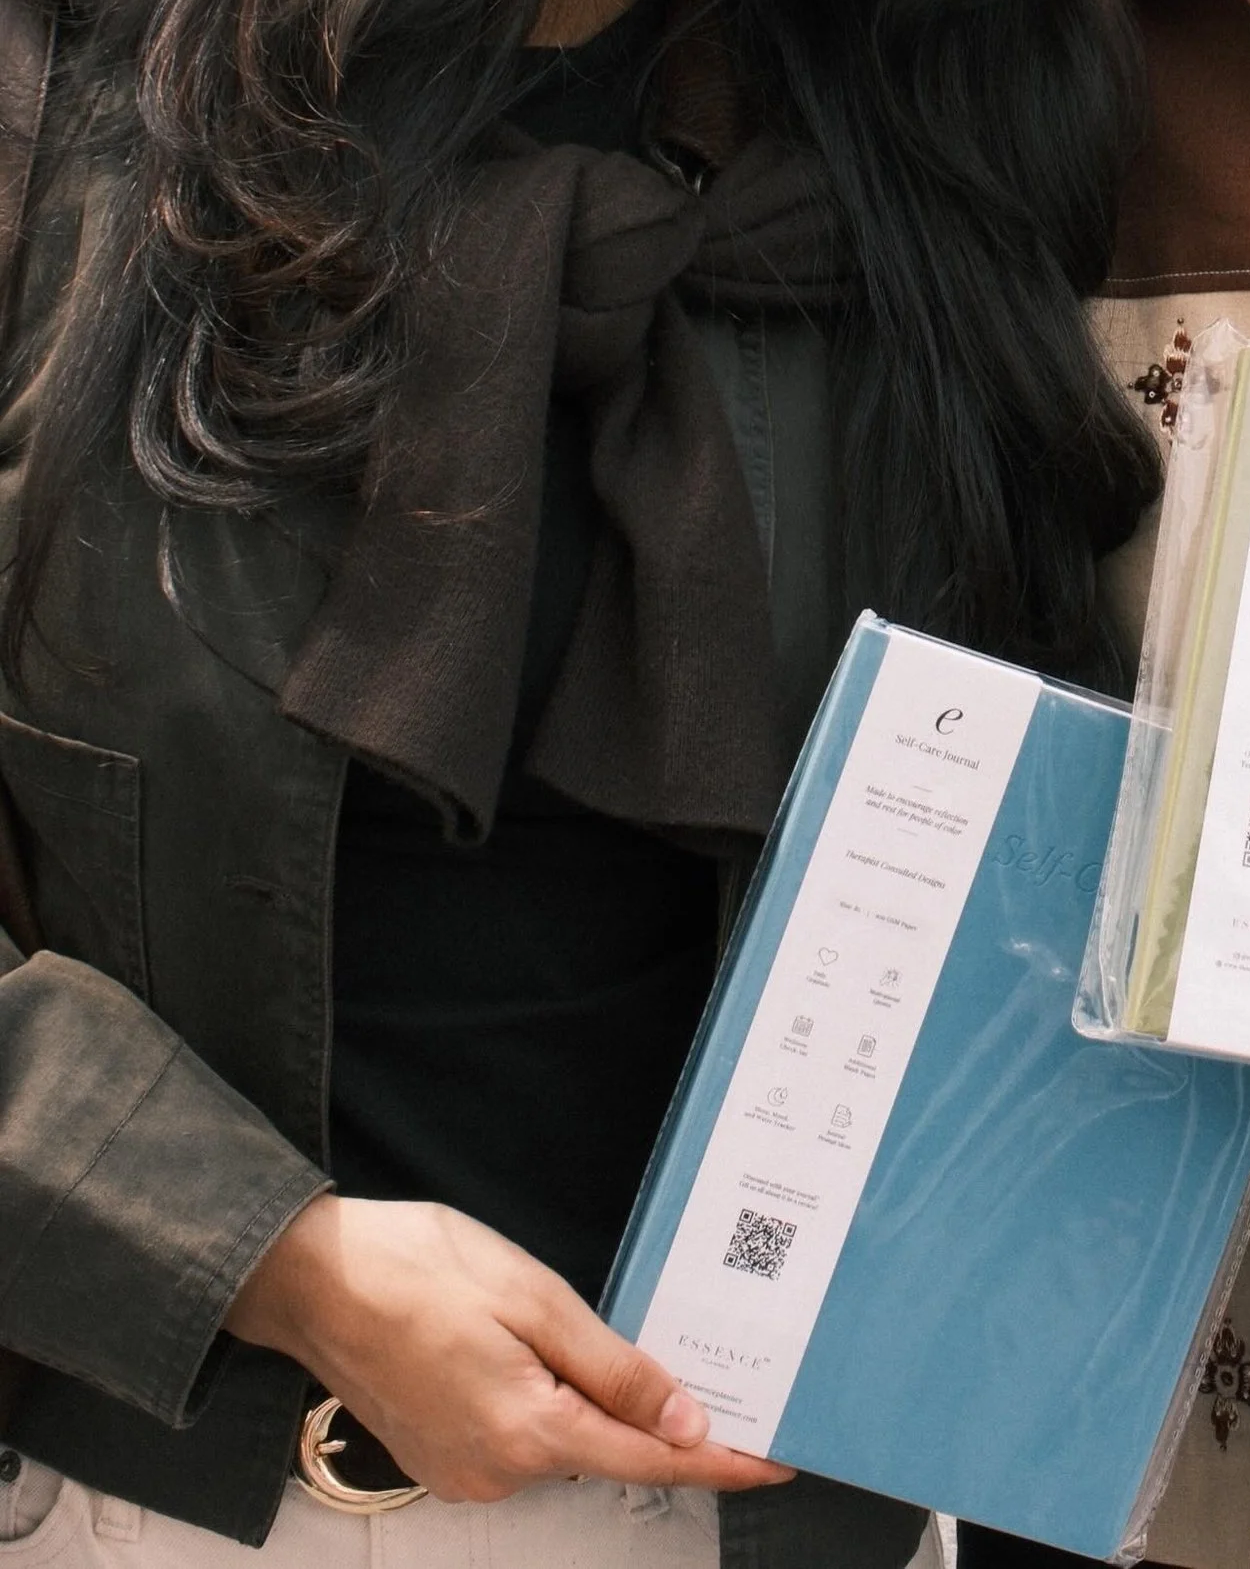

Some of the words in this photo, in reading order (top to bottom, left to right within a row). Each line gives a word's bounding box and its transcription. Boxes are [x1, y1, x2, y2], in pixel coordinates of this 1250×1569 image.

[935, 708, 963, 733] e
[895, 734, 942, 757] Self-Care
[942, 750, 979, 770] Journal
[866, 784, 886, 797] Made
[886, 792, 895, 800] to
[865, 799, 882, 808] and
[908, 812, 933, 826] people
[933, 822, 944, 830] of
[942, 825, 962, 835] color
[917, 874, 945, 888] Designs
